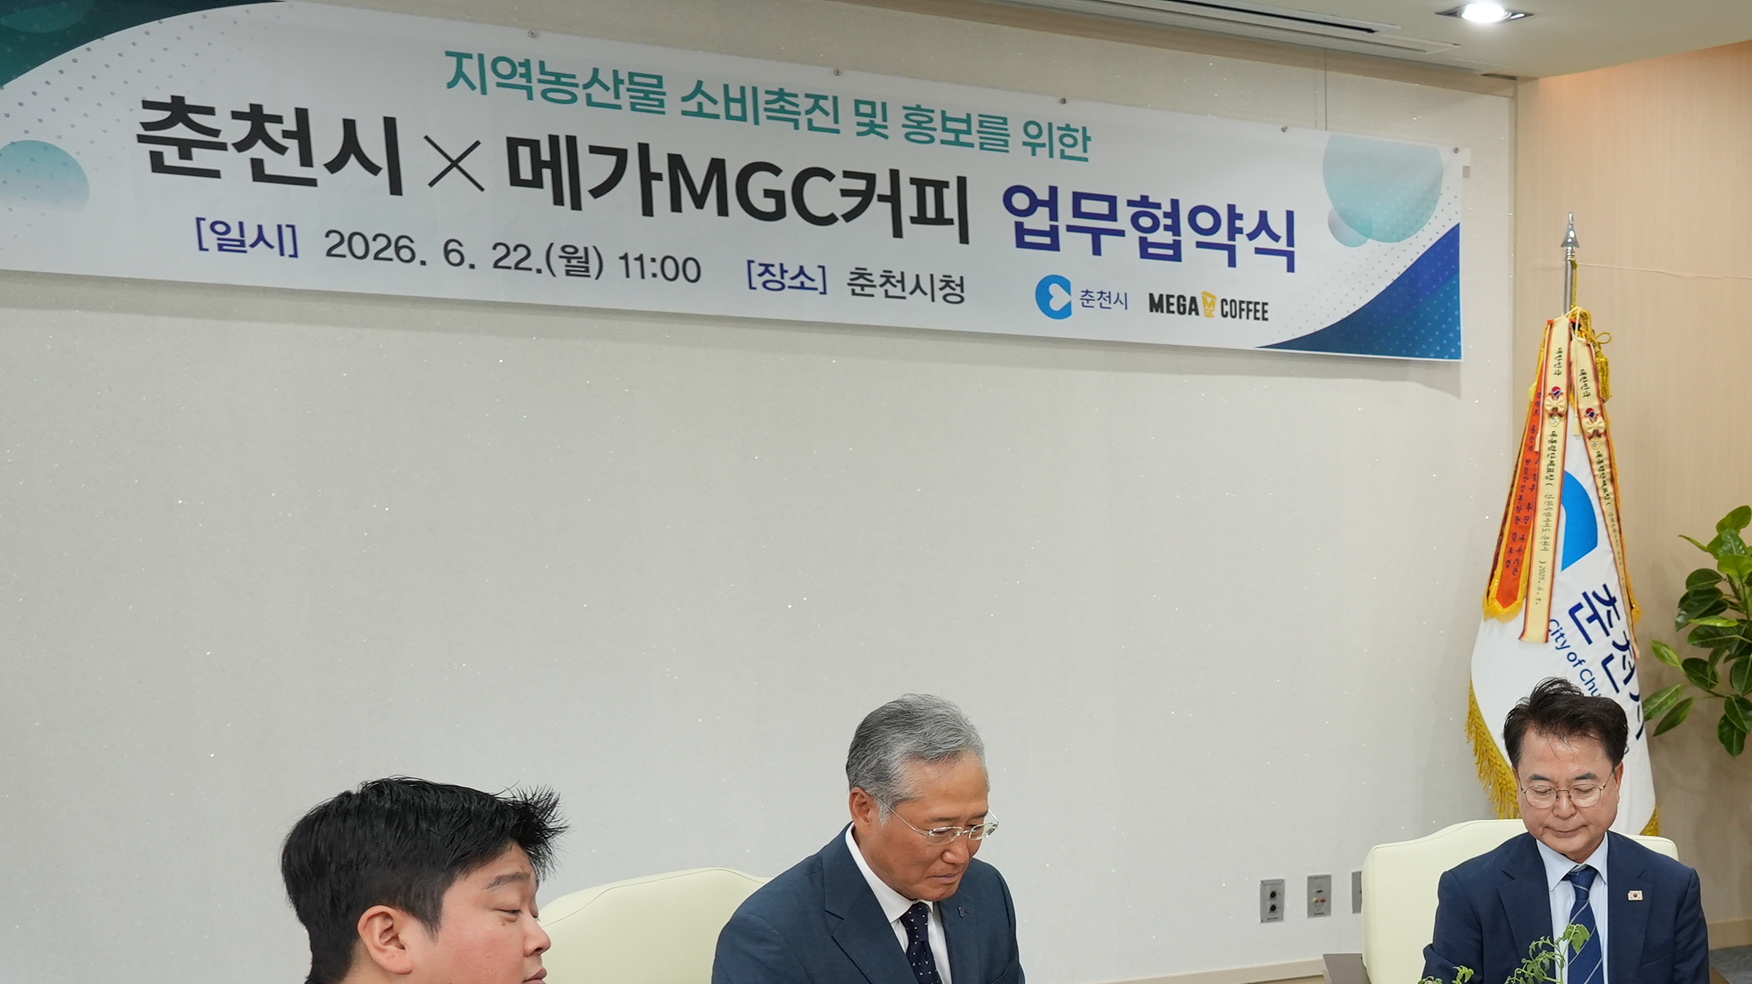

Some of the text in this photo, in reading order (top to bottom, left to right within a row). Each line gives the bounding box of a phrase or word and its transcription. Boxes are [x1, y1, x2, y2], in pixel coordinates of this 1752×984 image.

[444, 49, 1092, 163] 지역농산물 소비촉진 및 홍보를 위한
[135, 95, 404, 197] 춘천시
[506, 133, 970, 245] 메가MGC커피
[1002, 183, 1297, 274] 업무협약식
[195, 216, 967, 305] [일시] 2026. 6. 22.(월) 11:00 [장소] 춘천시청
[1079, 288, 1129, 311] 춘천시
[1149, 292, 1269, 322] MEGA COFFEE
[1548, 618, 1571, 651] City
[1566, 651, 1586, 668] of
